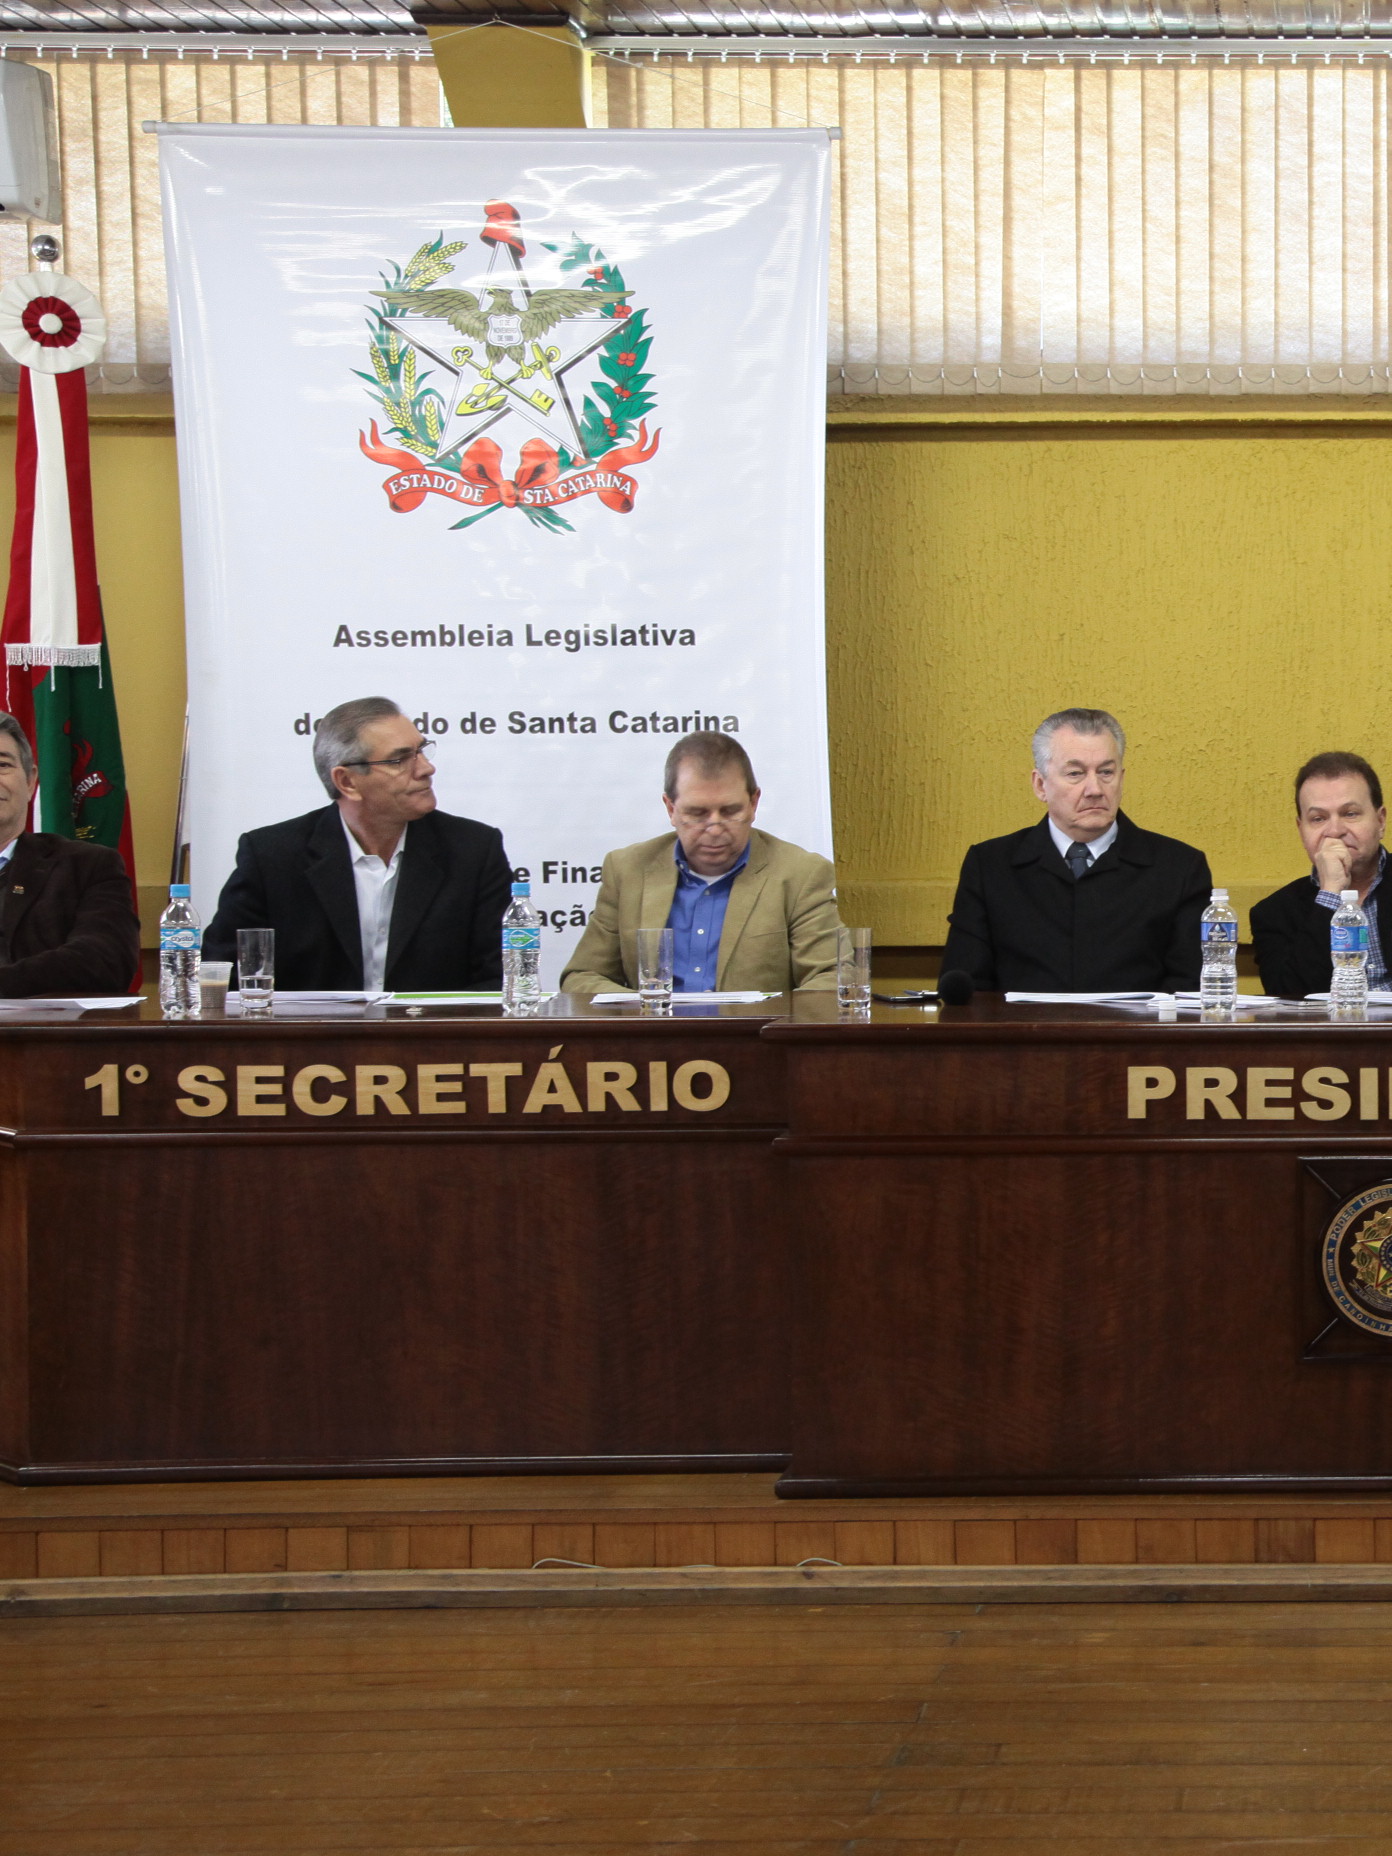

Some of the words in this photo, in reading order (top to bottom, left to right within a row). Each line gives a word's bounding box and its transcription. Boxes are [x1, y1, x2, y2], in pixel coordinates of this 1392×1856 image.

[389, 474, 457, 495] ESTADO
[460, 485, 485, 503] DE
[333, 624, 513, 647] Assembleia
[525, 623, 696, 653] Legislativa
[460, 711, 496, 735] de
[508, 711, 597, 734] Santa
[608, 709, 740, 733] Catarina
[175, 1044, 731, 1117] SECRETÁRIO
[1330, 1207, 1356, 1240] PODER
